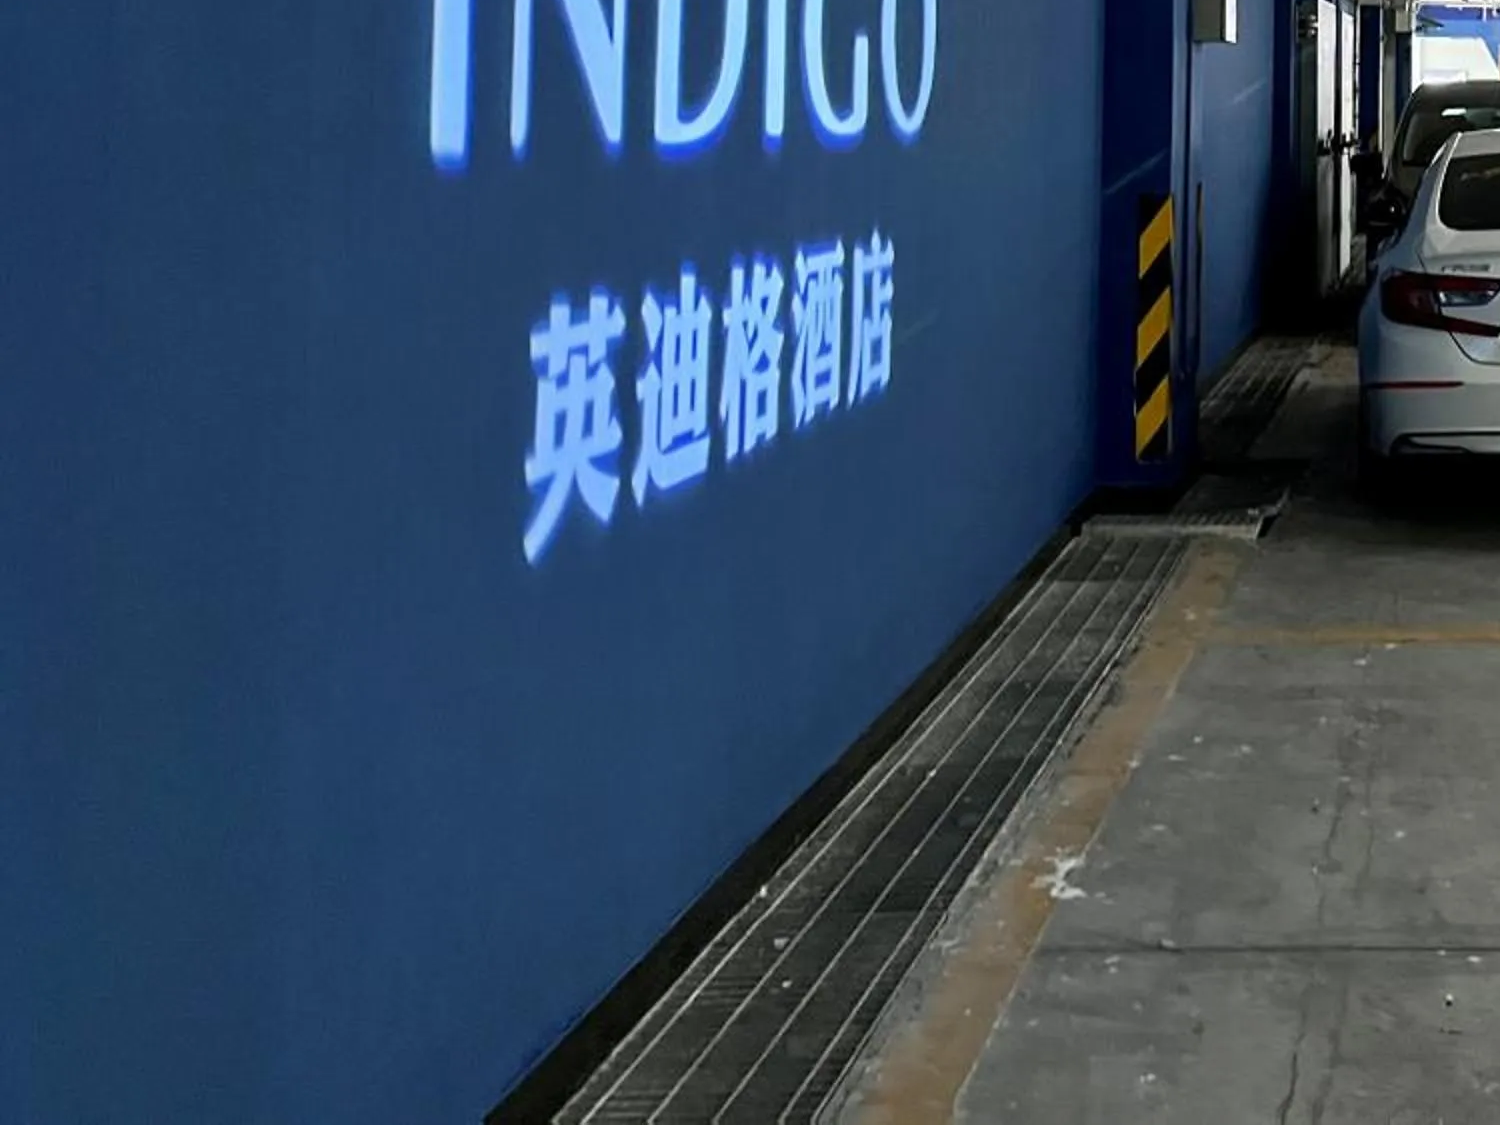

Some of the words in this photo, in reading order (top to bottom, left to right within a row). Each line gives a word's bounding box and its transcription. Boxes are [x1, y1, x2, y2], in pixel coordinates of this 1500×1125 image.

[522, 229, 897, 564] 英迪格酒店
